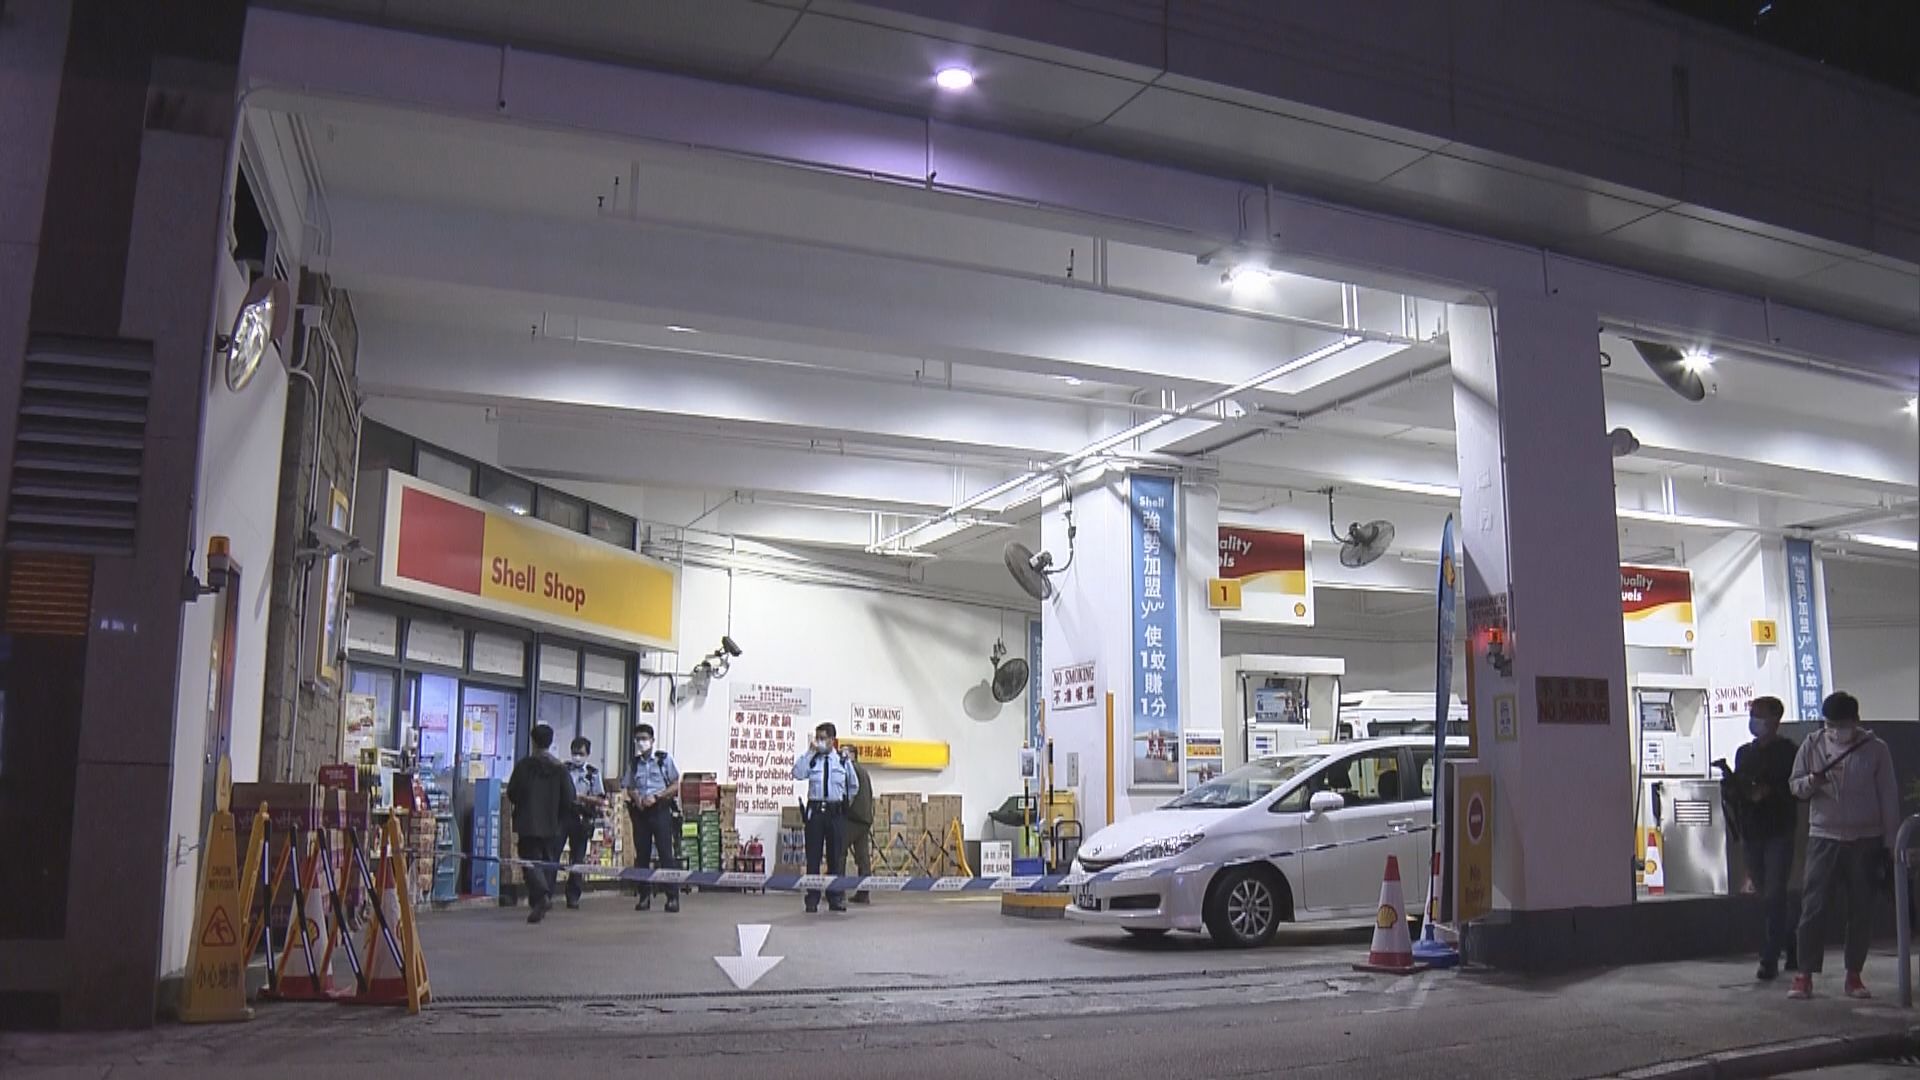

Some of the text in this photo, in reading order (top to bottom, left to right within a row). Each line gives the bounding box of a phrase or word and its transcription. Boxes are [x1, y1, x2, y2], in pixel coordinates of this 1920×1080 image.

[1139, 495, 1164, 508] Shell
[1219, 534, 1252, 555] ality
[491, 557, 586, 612] Shell Shop
[1220, 585, 1227, 601] 1
[1621, 588, 1642, 601] uels
[1764, 626, 1771, 639] 3
[1053, 666, 1095, 687] NO SMOKING
[1715, 686, 1753, 701] SMOKING
[854, 706, 901, 721] NO SMOKING
[1560, 702, 1608, 721] SMOKING
[728, 766, 795, 782] light is prohibited
[756, 782, 768, 795] the
[771, 783, 794, 799] petrol
[736, 797, 779, 813] ing station
[983, 864, 994, 873] FIRE
